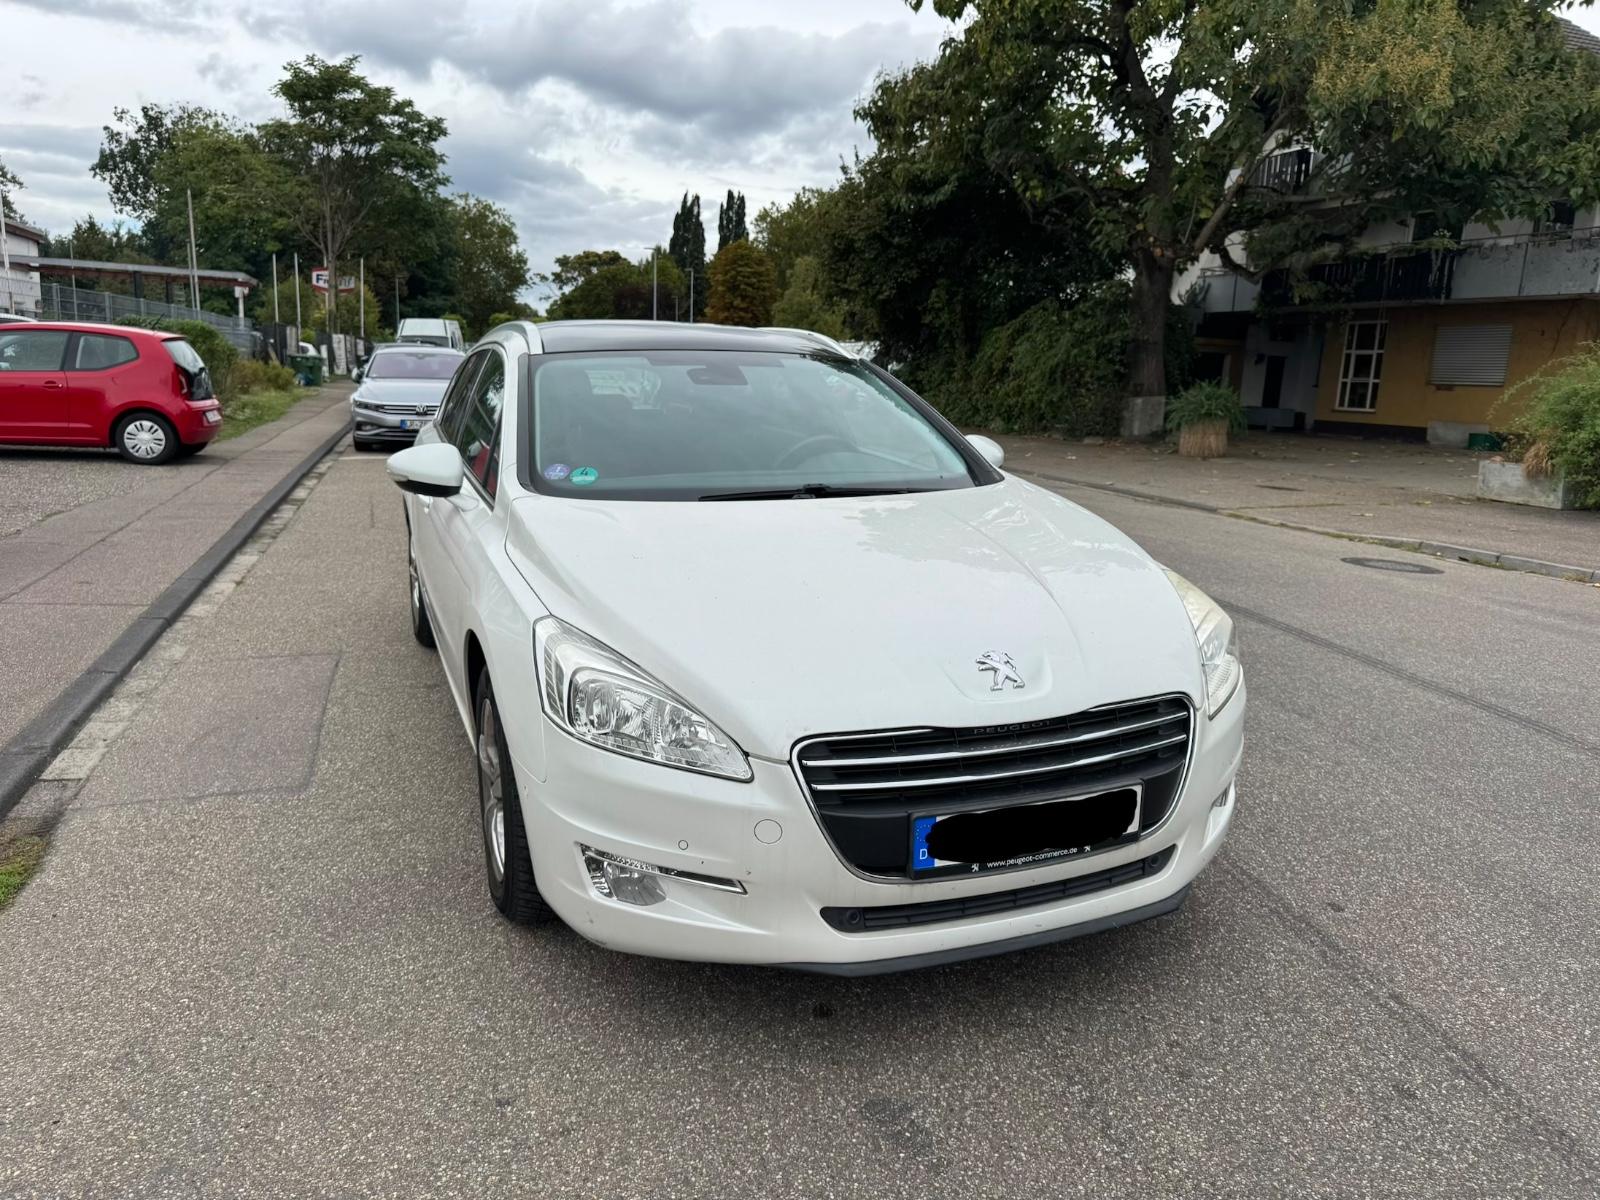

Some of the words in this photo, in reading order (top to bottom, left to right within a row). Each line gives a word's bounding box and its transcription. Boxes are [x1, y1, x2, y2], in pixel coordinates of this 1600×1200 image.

[580, 467, 589, 476] 4
[974, 720, 1051, 735] PEUGEOT
[919, 848, 928, 860] D
[987, 847, 1078, 868] www.peugeot-commerce.de
